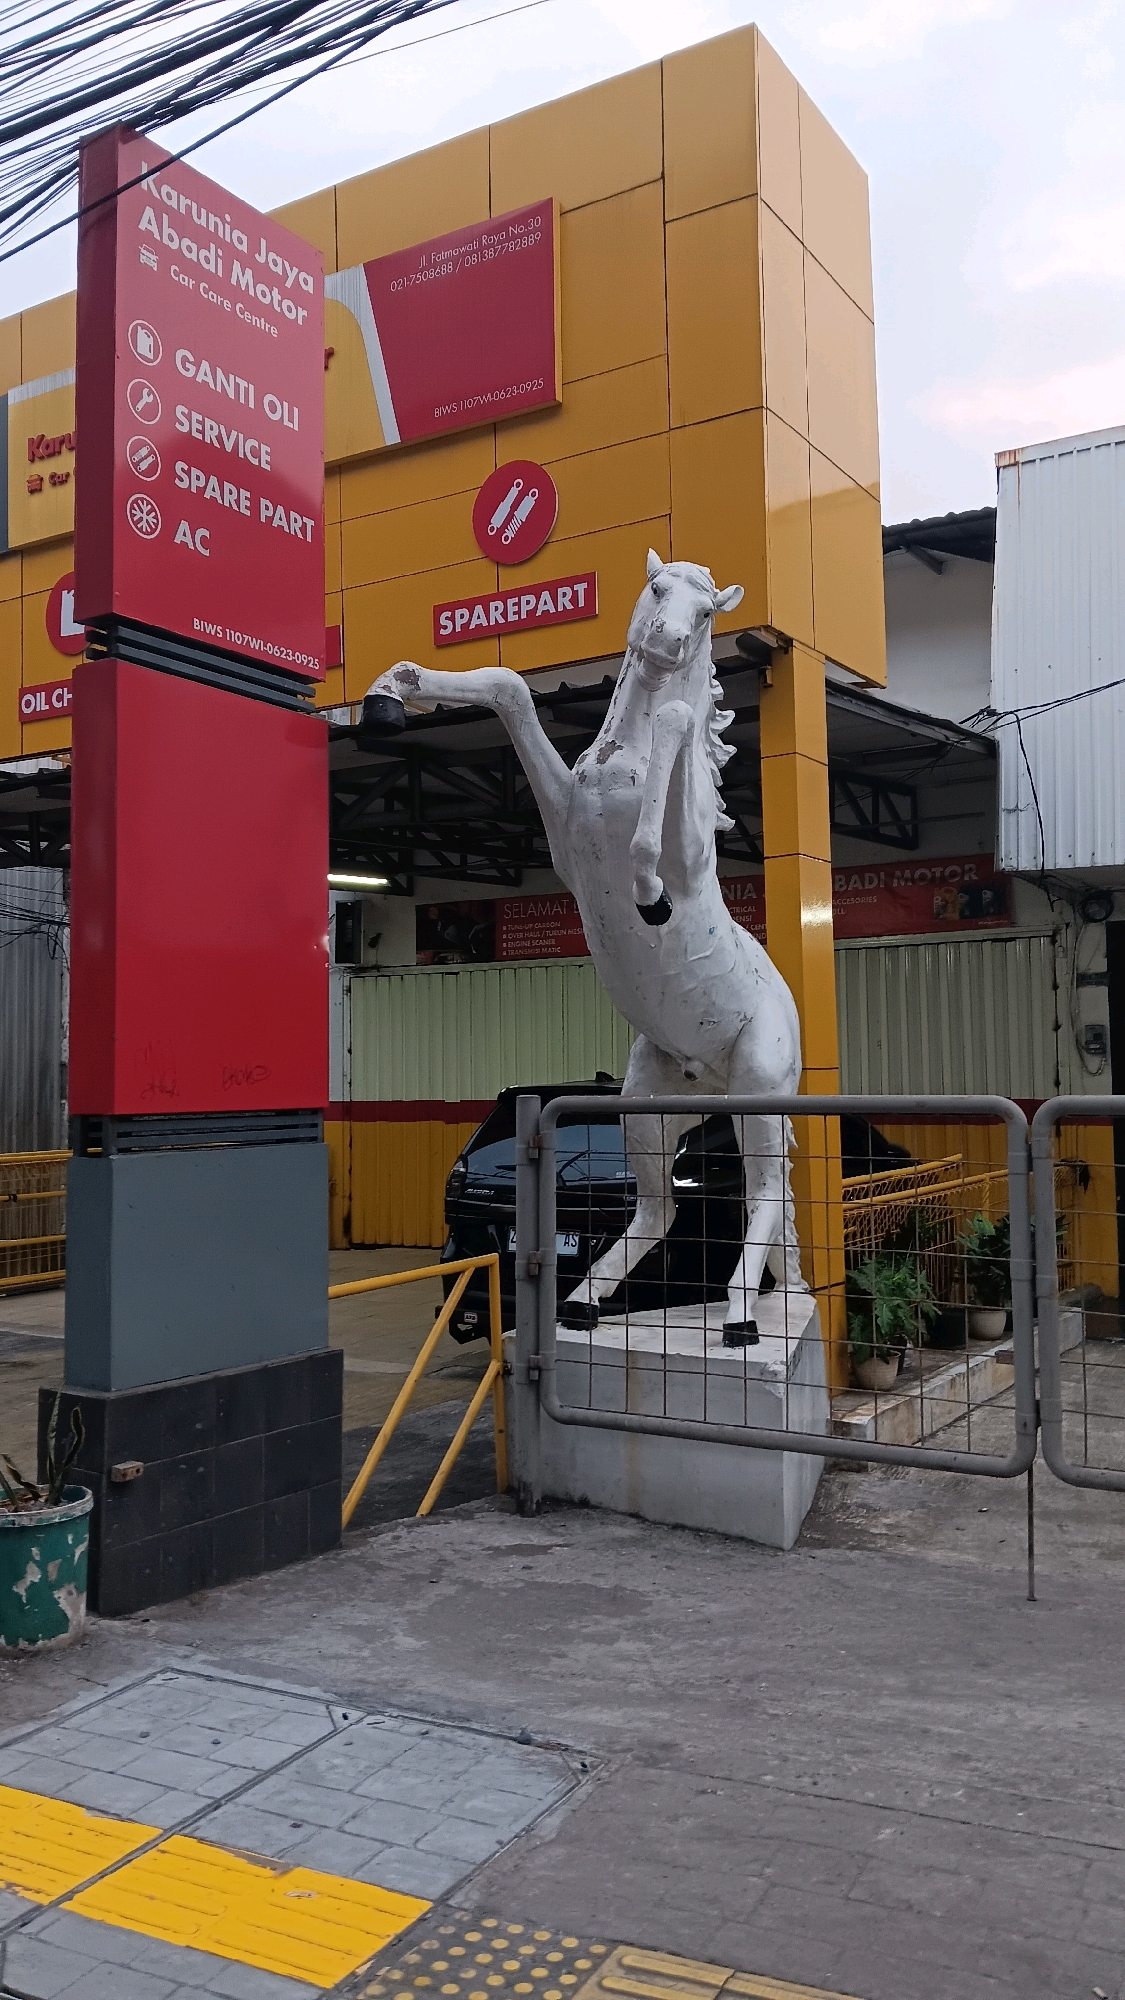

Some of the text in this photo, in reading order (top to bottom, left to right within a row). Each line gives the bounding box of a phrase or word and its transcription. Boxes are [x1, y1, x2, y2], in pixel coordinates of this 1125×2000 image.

[140, 161, 314, 294] Karunia Jaya
[418, 216, 542, 268] Jl. Fatmawati Raya No.30
[138, 205, 308, 325] Abadi Motor
[390, 262, 453, 292] 021-7508688
[464, 231, 542, 267] 081387782889
[170, 264, 279, 338] Car Care Centre
[175, 348, 299, 432] GANTI OLI
[434, 402, 458, 418] BIWS
[174, 404, 272, 472] SERVICE
[48, 472, 70, 486] Car
[174, 460, 315, 543] SPARE PART
[173, 520, 211, 557] AC
[439, 582, 588, 636] SPAREPART
[193, 617, 320, 670] BIWS 1107WI-0623-0925
[21, 691, 50, 714] OIL
[503, 899, 570, 919] SELAMAT
[834, 871, 885, 892] BADI
[892, 863, 979, 888] MOTOR
[507, 921, 561, 931] TUNE-UP CARBON
[507, 932, 524, 940] OVER
[507, 938, 556, 948] ENGINE SCANER
[507, 946, 561, 956] TRANSMISI MATIC
[563, 1232, 578, 1248] AS
